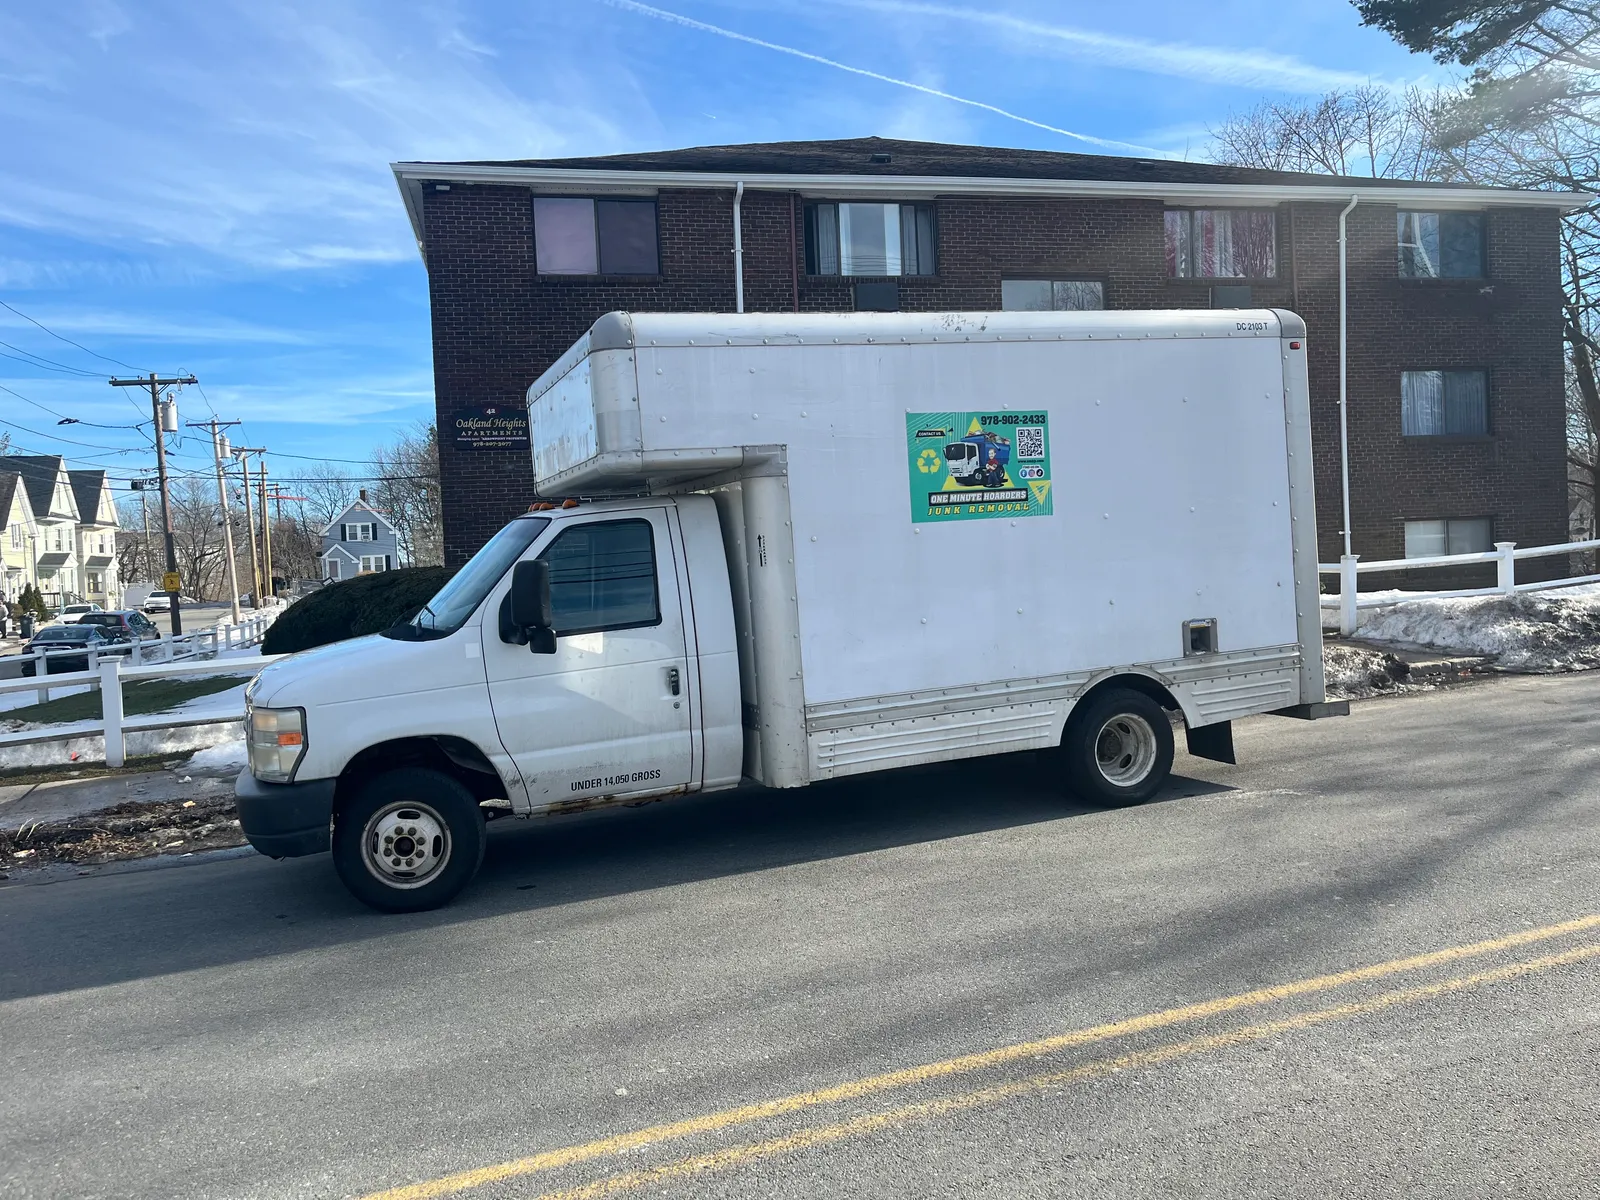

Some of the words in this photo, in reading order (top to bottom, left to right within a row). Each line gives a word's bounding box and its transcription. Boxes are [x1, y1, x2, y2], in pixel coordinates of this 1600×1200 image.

[1236, 323, 1246, 331] DC
[1248, 323, 1263, 331] 2103
[456, 418, 492, 429] Oakland
[493, 418, 527, 430] Heights
[980, 414, 1046, 425] 978-902-2433
[930, 494, 949, 504] ONE
[949, 493, 982, 503] MINUTE
[983, 490, 1026, 501] HOARDERS
[927, 505, 961, 516] JUNK
[968, 502, 1029, 513] REMOVAL
[571, 778, 602, 791] UNDER
[604, 774, 629, 786] 14,050
[632, 769, 661, 782] GROSS
